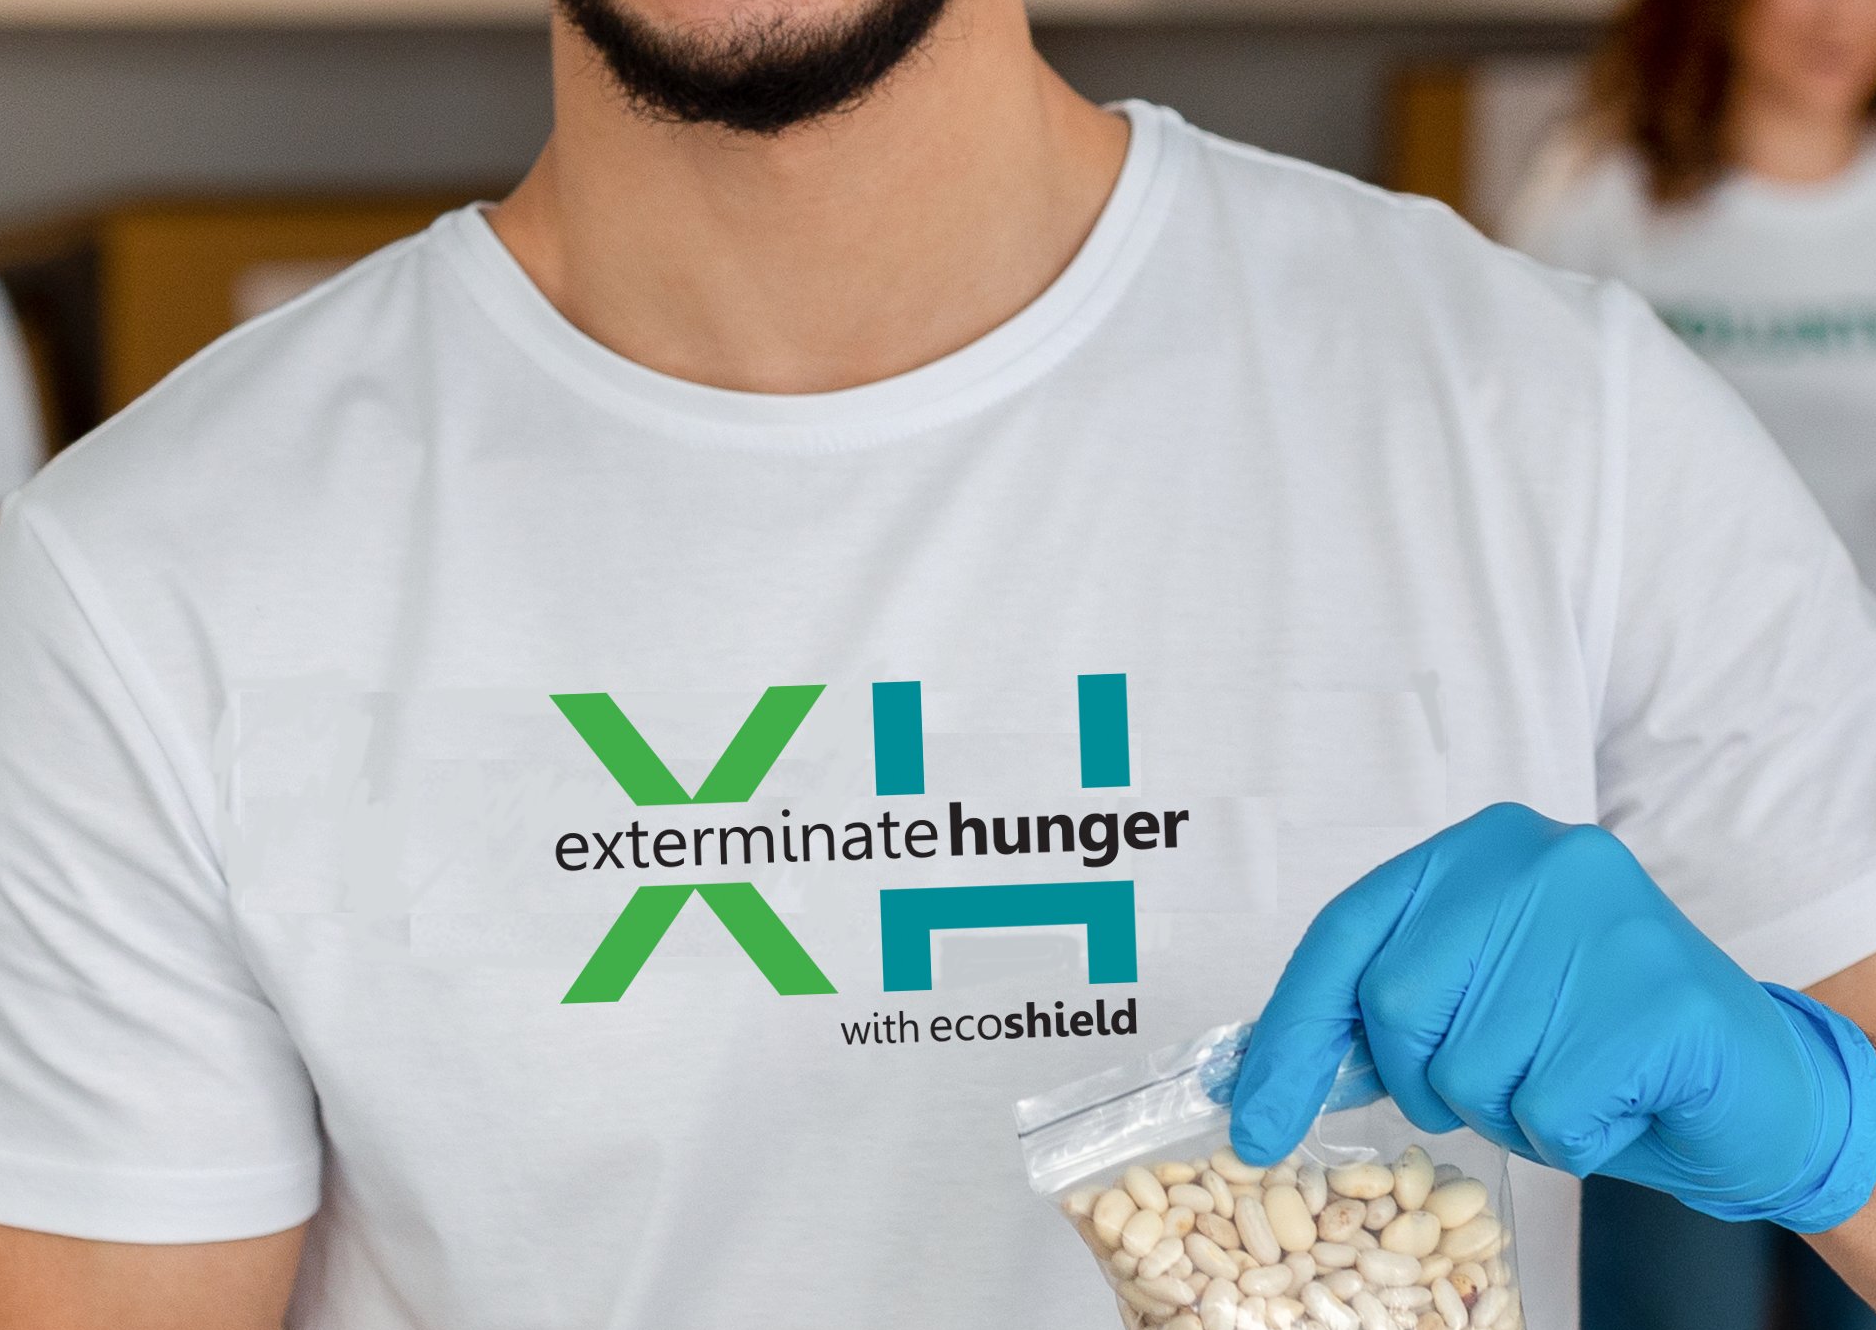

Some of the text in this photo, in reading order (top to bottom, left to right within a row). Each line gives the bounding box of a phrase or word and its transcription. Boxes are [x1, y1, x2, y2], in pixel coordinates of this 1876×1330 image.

[555, 802, 1190, 872] exterminate hunger
[840, 998, 1138, 1045] with ecoshield
